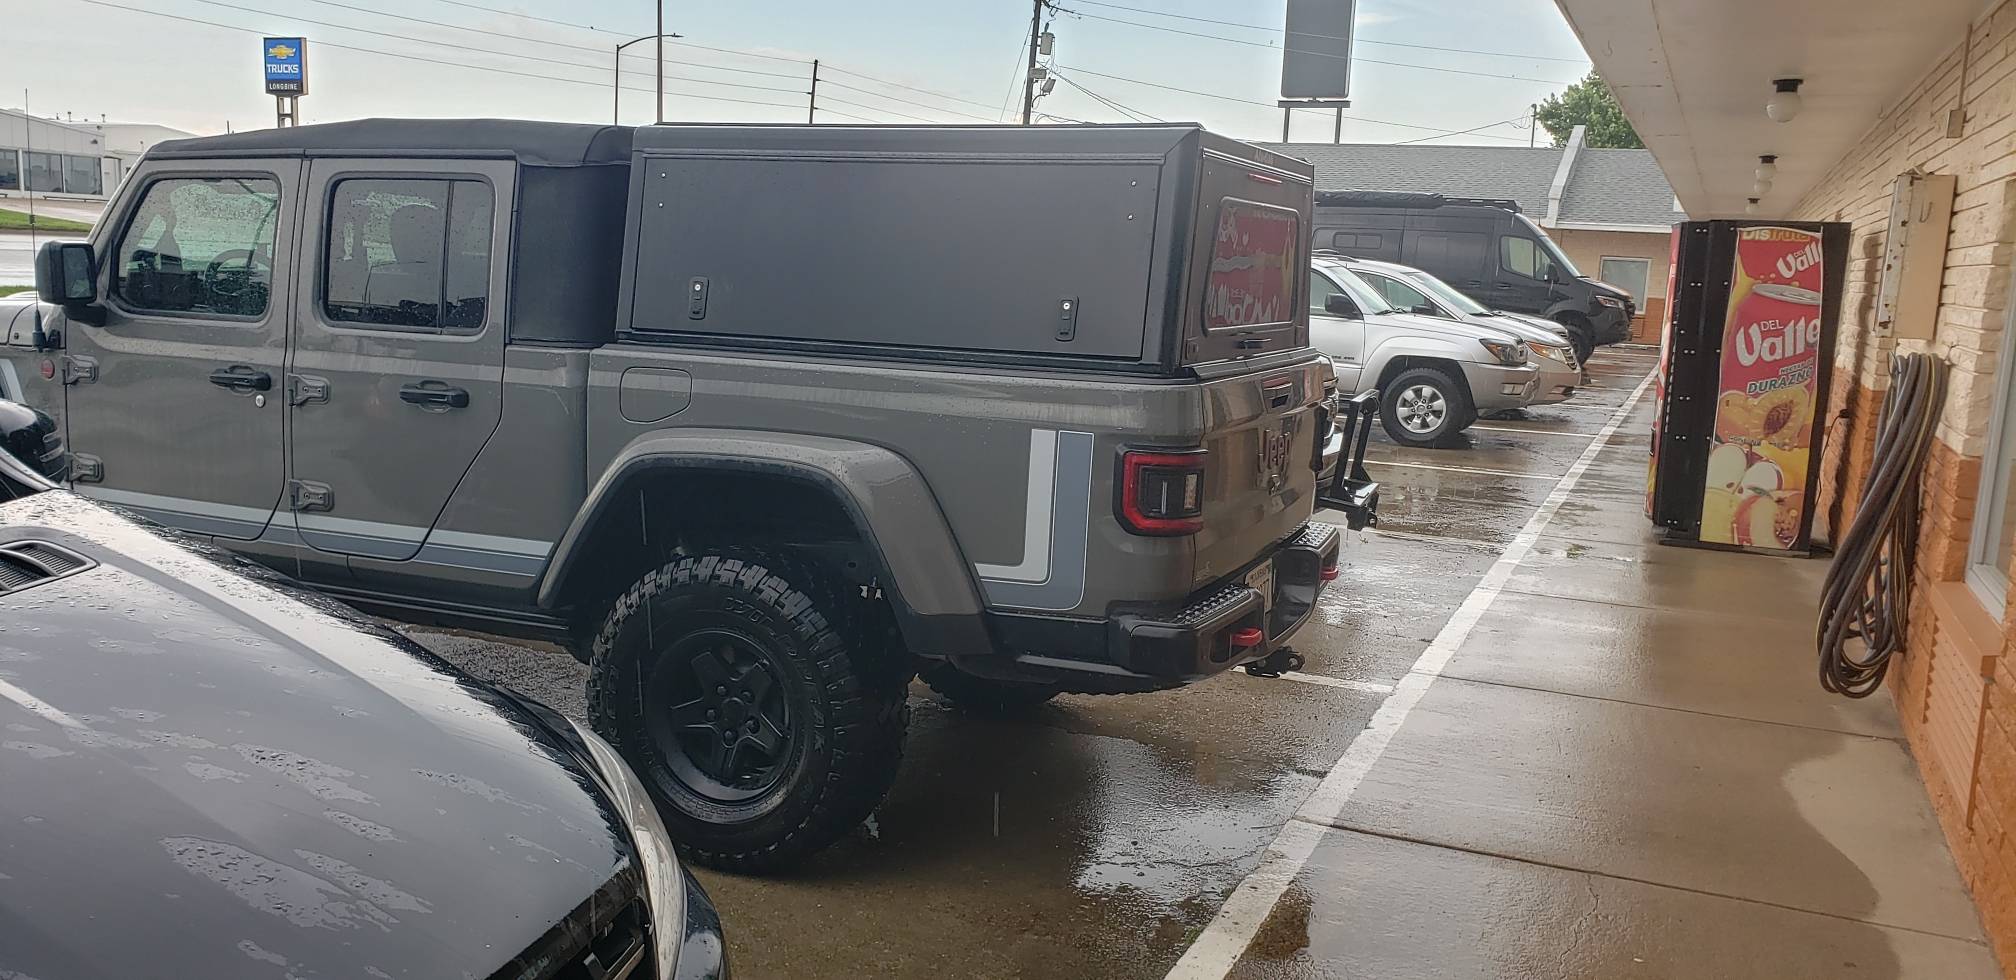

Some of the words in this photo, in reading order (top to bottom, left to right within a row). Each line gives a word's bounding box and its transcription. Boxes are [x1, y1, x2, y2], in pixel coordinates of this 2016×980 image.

[266, 64, 299, 73] TRUCKS
[1760, 319, 1784, 331] DEL
[1736, 316, 1820, 367] Valle
[1257, 429, 1291, 473] Jeep
